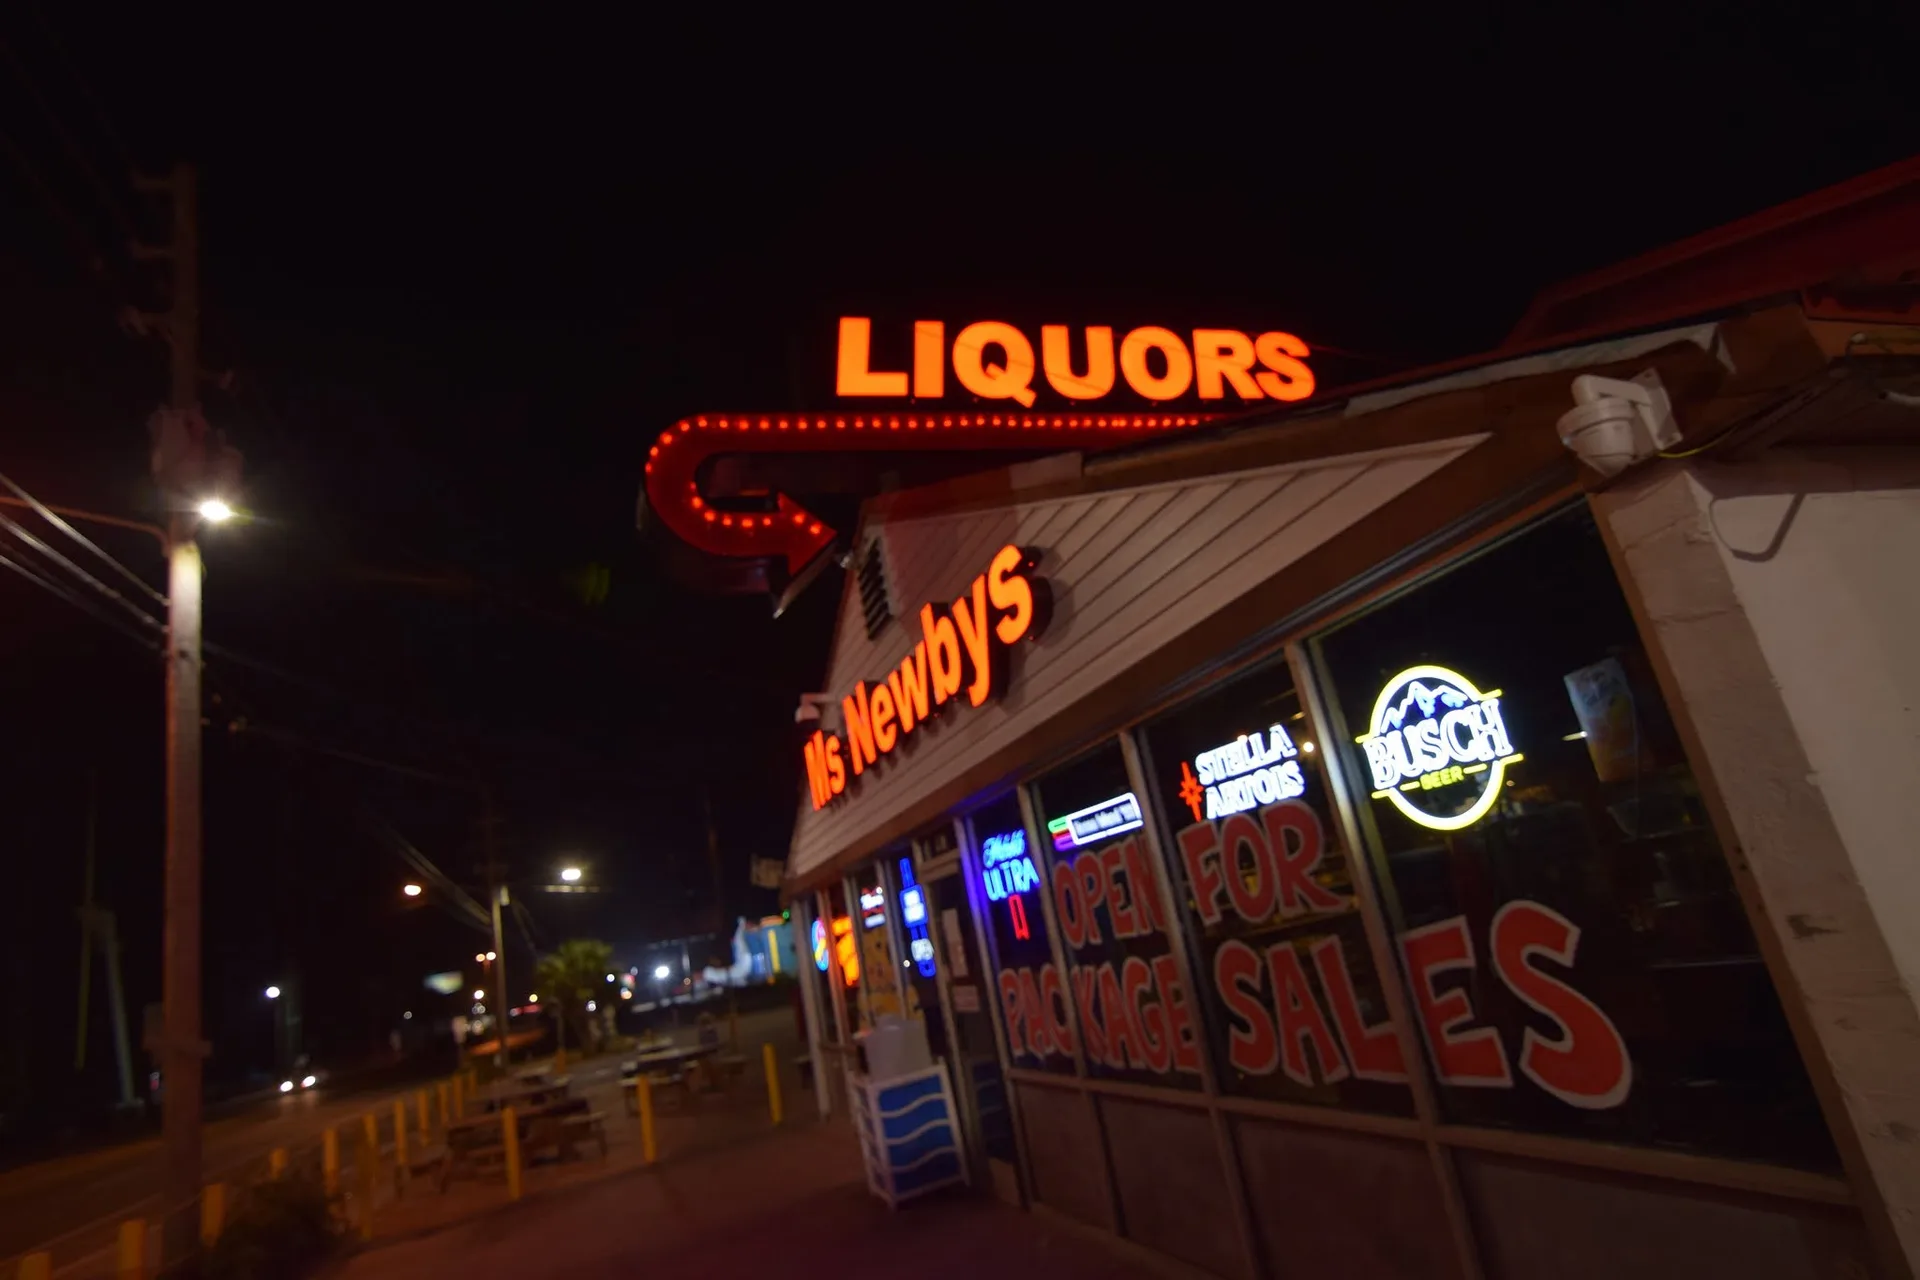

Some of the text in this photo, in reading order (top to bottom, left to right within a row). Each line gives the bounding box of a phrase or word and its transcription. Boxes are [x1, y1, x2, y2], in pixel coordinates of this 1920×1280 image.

[836, 317, 1316, 407] LIQUORS
[804, 544, 1033, 811] Ms Newbys
[1195, 724, 1297, 785] STELLA
[1363, 698, 1514, 790] BUSCH
[1420, 765, 1464, 791] BEER
[1205, 760, 1304, 819] ARTOIS
[983, 857, 1040, 901] ULTRA
[1054, 802, 1354, 948] OPEN FOR
[998, 900, 1632, 1109] PACKAGE SALES
